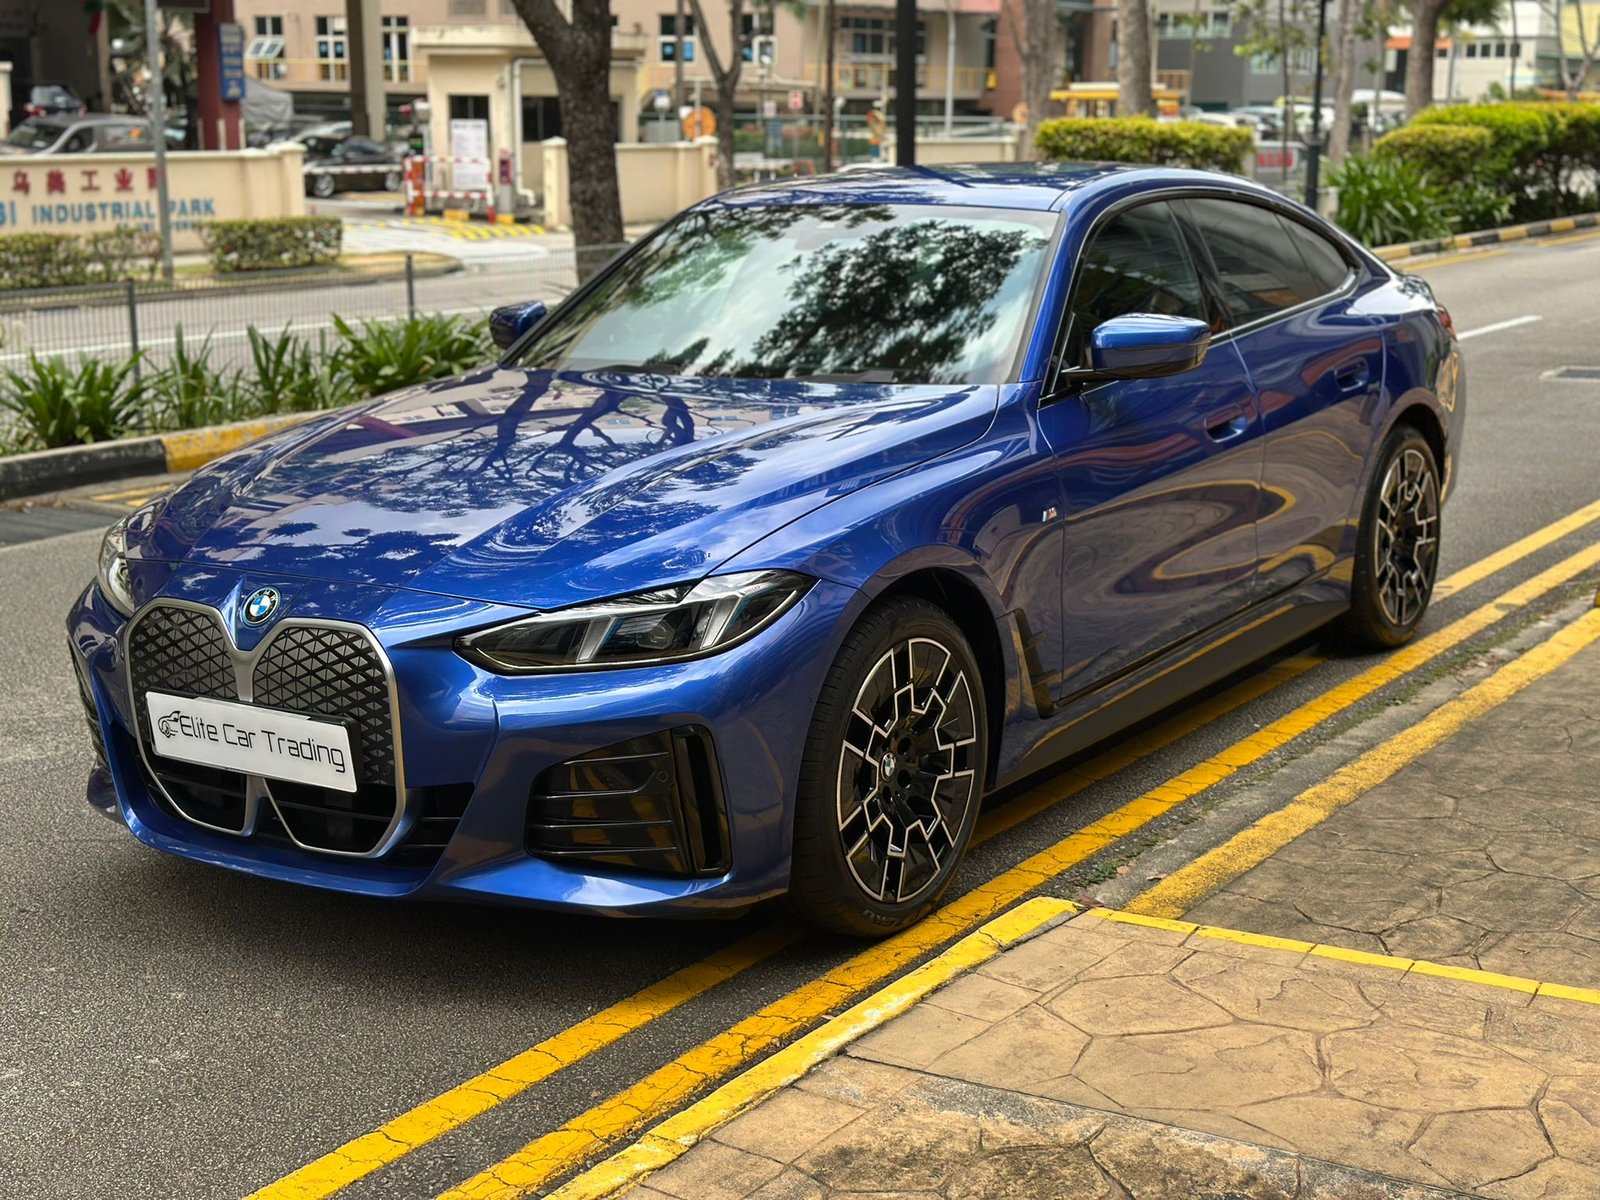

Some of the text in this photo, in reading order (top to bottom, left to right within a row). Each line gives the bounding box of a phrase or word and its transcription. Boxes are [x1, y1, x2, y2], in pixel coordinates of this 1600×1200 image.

[32, 200, 155, 224] INDUSTRIAL
[166, 197, 215, 216] PARK
[179, 714, 346, 773] Elite Car Trading
